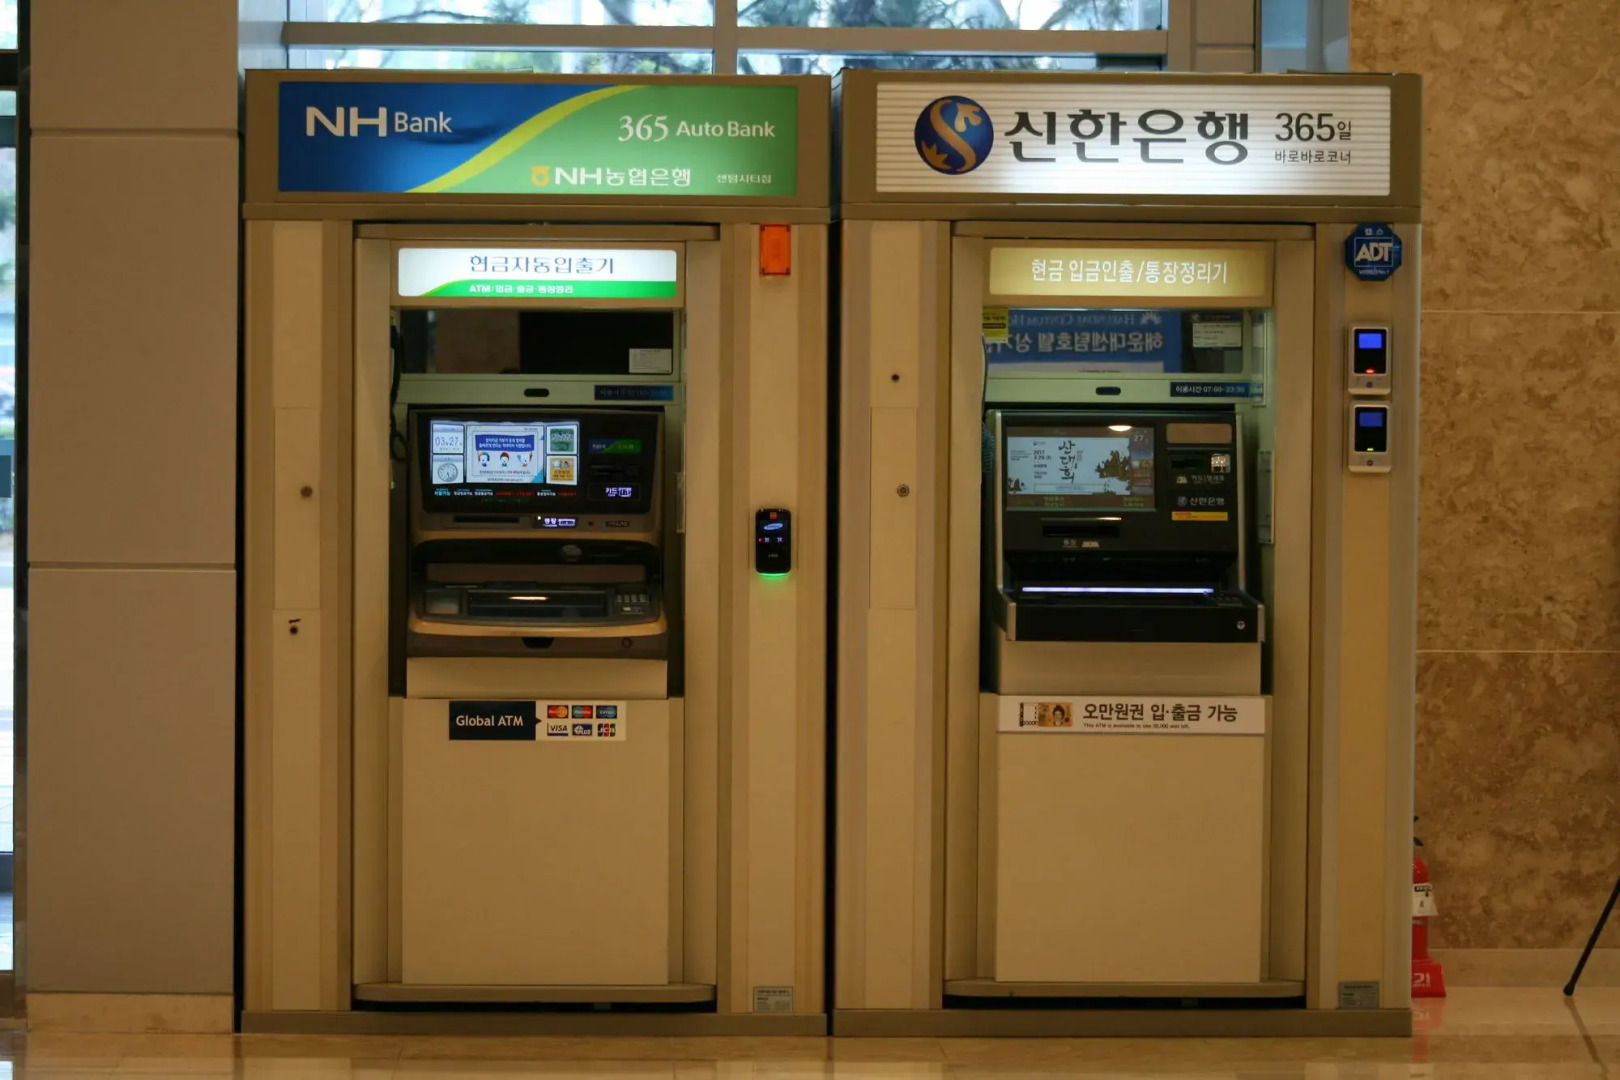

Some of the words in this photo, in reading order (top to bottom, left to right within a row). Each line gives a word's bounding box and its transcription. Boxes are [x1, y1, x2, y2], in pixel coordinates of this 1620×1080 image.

[306, 106, 387, 137] NH
[395, 111, 453, 133] Bank
[617, 114, 669, 142] 365
[676, 121, 724, 137] Auto
[728, 122, 776, 137] Bank
[1004, 109, 1249, 166] 신한은행
[1275, 149, 1352, 164] 바로바로코너
[1355, 242, 1393, 262] ADT
[1031, 259, 1065, 283] 현금
[456, 715, 495, 727] Global
[498, 715, 524, 727] ATM
[1083, 703, 1145, 721] 오만원권
[1151, 703, 1202, 722] 입·출금
[1207, 704, 1238, 723] 가능
[550, 724, 568, 732] VISA
